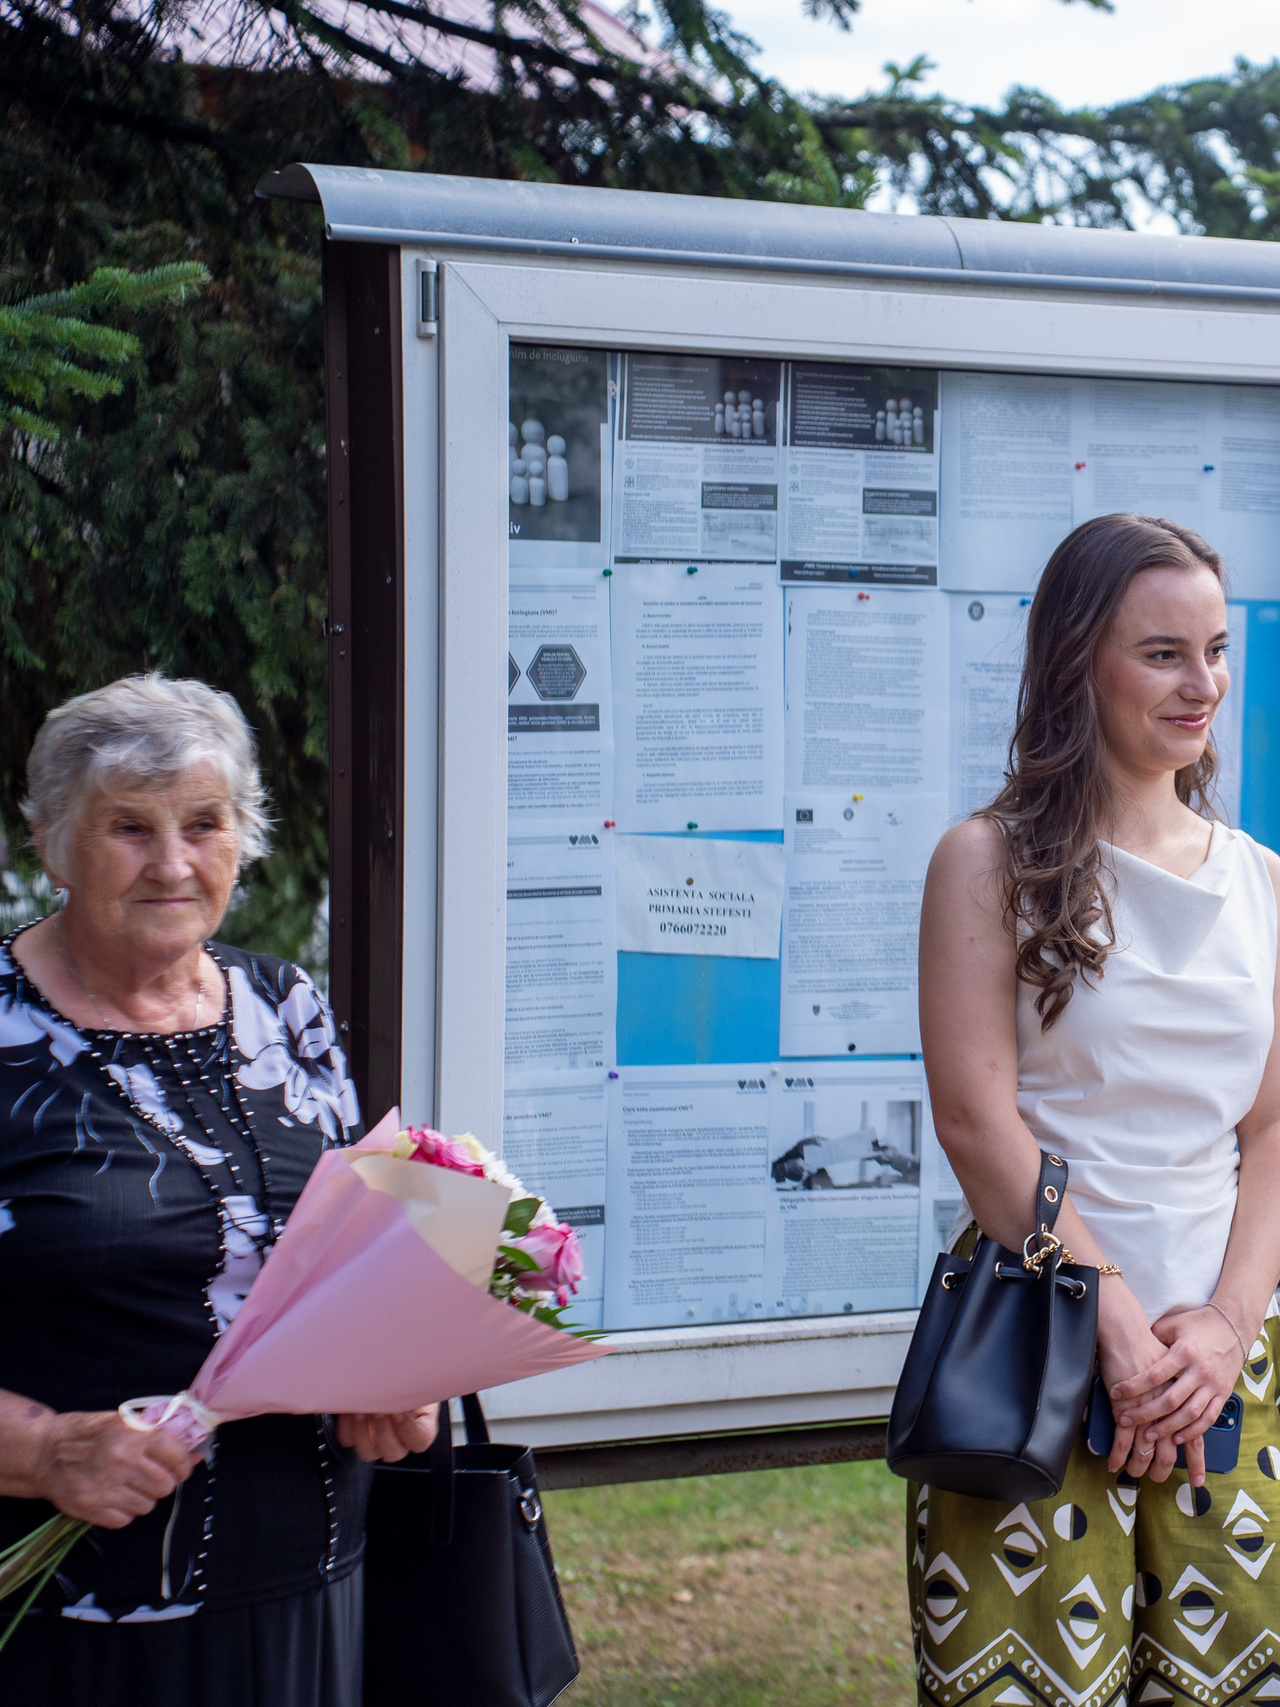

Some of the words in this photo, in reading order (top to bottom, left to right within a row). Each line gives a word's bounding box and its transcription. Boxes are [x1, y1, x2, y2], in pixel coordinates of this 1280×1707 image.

[647, 888, 703, 900] ASISTENTA
[708, 890, 755, 903] SOCIALA
[648, 903, 700, 915] PRIMARIA
[703, 906, 751, 919] STEFESTI
[659, 921, 727, 936] 0766072220
